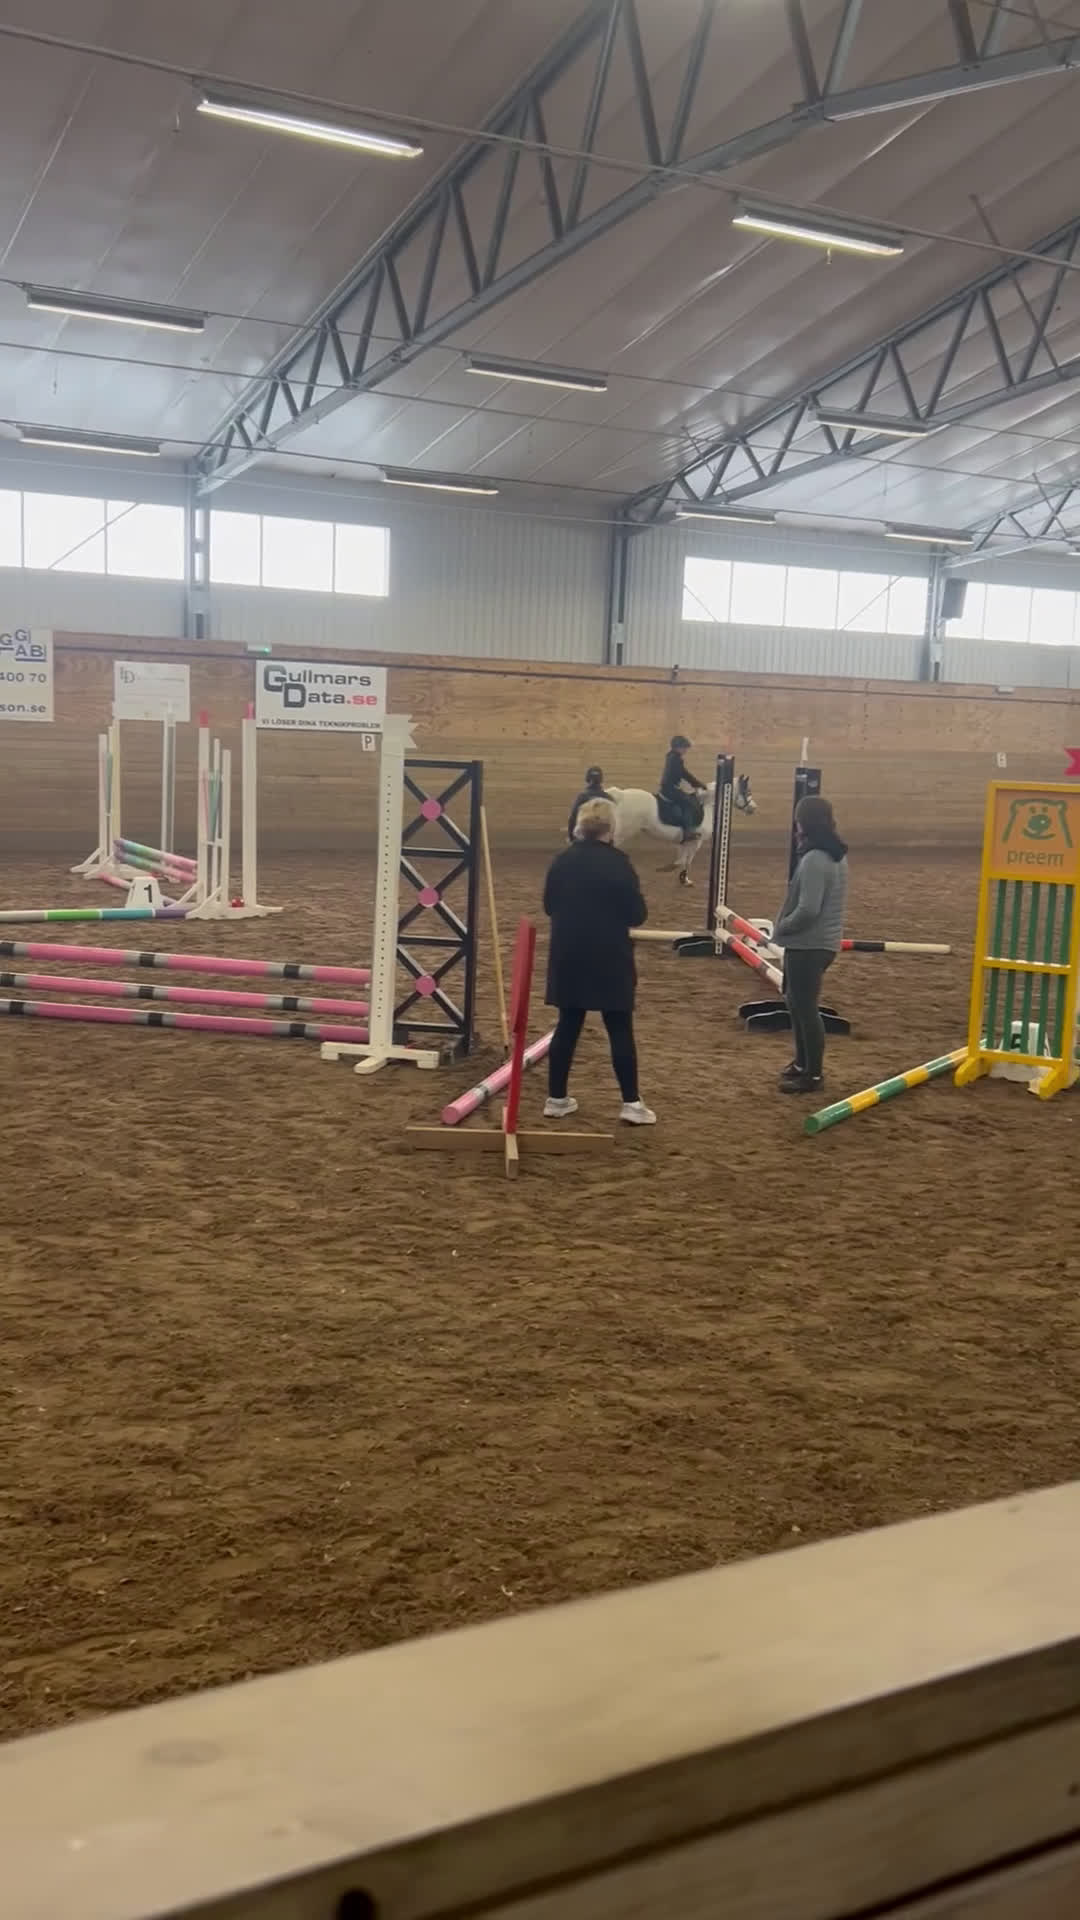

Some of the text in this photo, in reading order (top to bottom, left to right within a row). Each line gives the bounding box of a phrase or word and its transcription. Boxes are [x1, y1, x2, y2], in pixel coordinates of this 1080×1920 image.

[264, 664, 372, 692] Gullmars
[284, 683, 377, 708] Data.se
[365, 735, 373, 749] P
[1007, 850, 1065, 867] preem
[144, 884, 153, 903] 1
